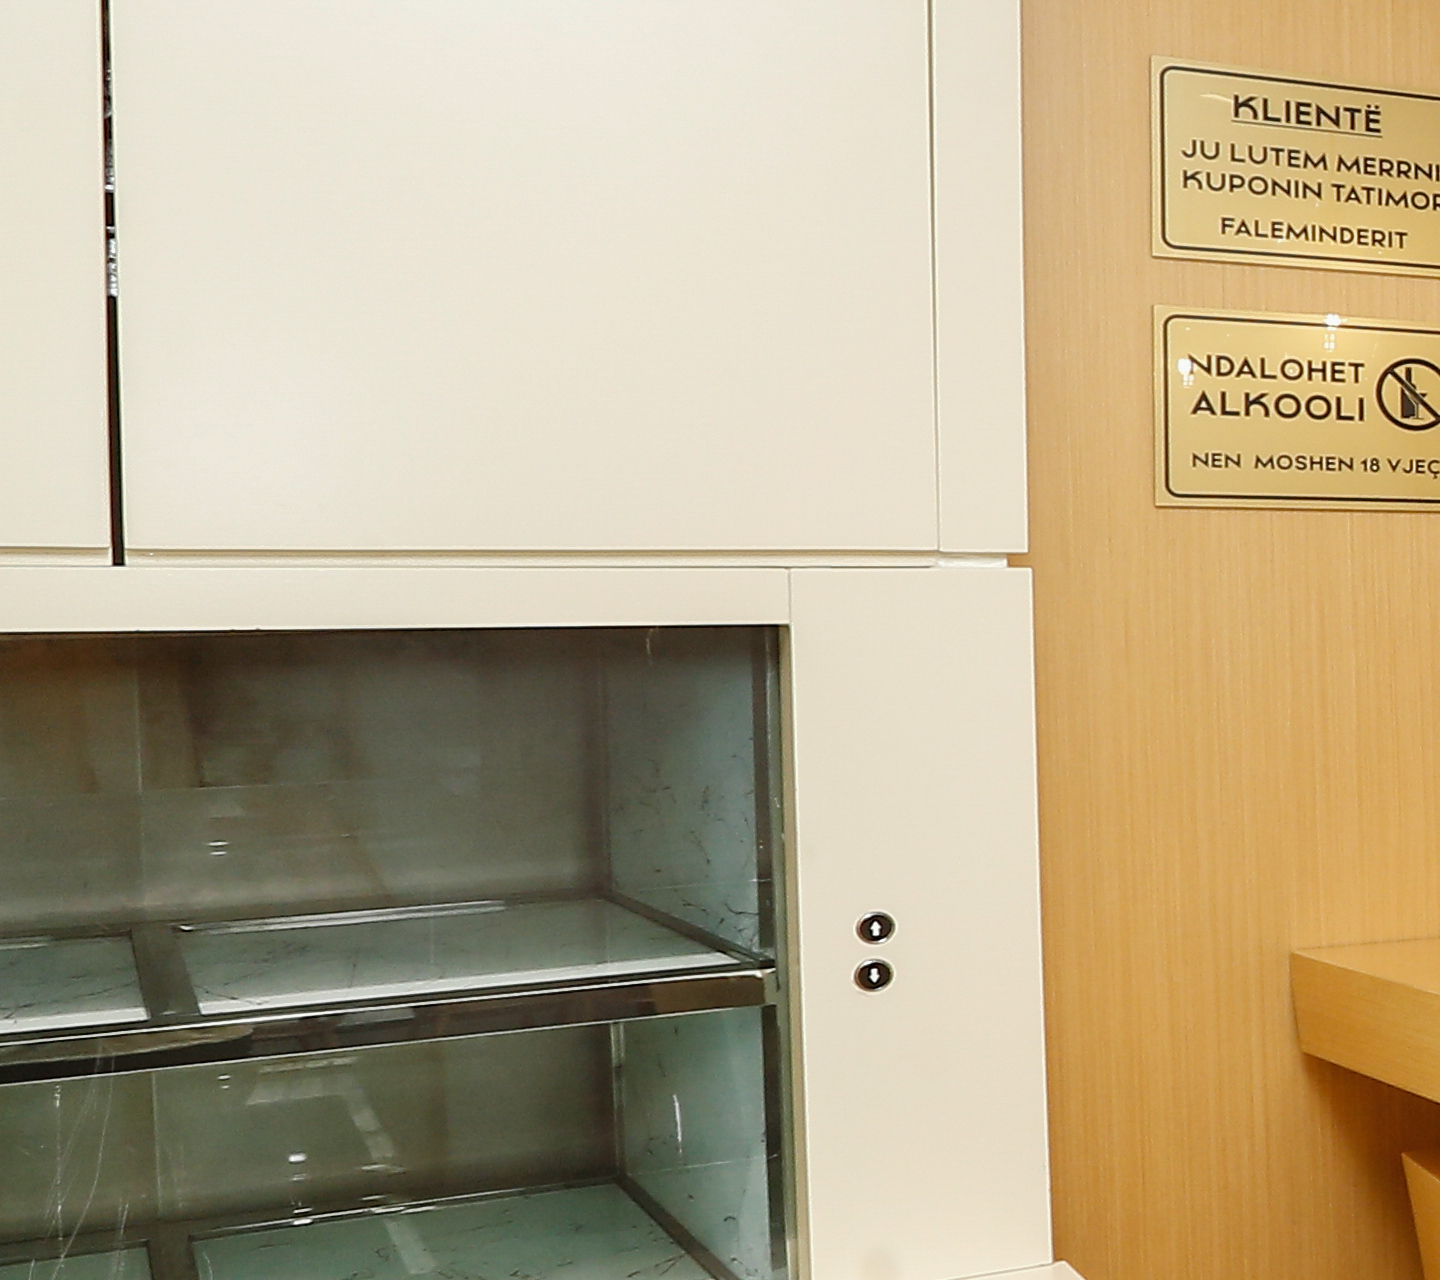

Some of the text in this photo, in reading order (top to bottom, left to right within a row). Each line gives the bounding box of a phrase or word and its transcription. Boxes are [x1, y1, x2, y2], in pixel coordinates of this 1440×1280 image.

[1233, 94, 1382, 133] KLIENTË
[1181, 139, 1440, 182] JU LUTEM MERRNI
[1182, 170, 1322, 200] KUPONIN
[1221, 217, 1408, 249] FALEMINDERIT
[1188, 354, 1365, 384] NDALOHET
[1191, 390, 1365, 422] ALKOOLI
[1192, 453, 1440, 479] NEN MOSHEN 18 VJEÇ
